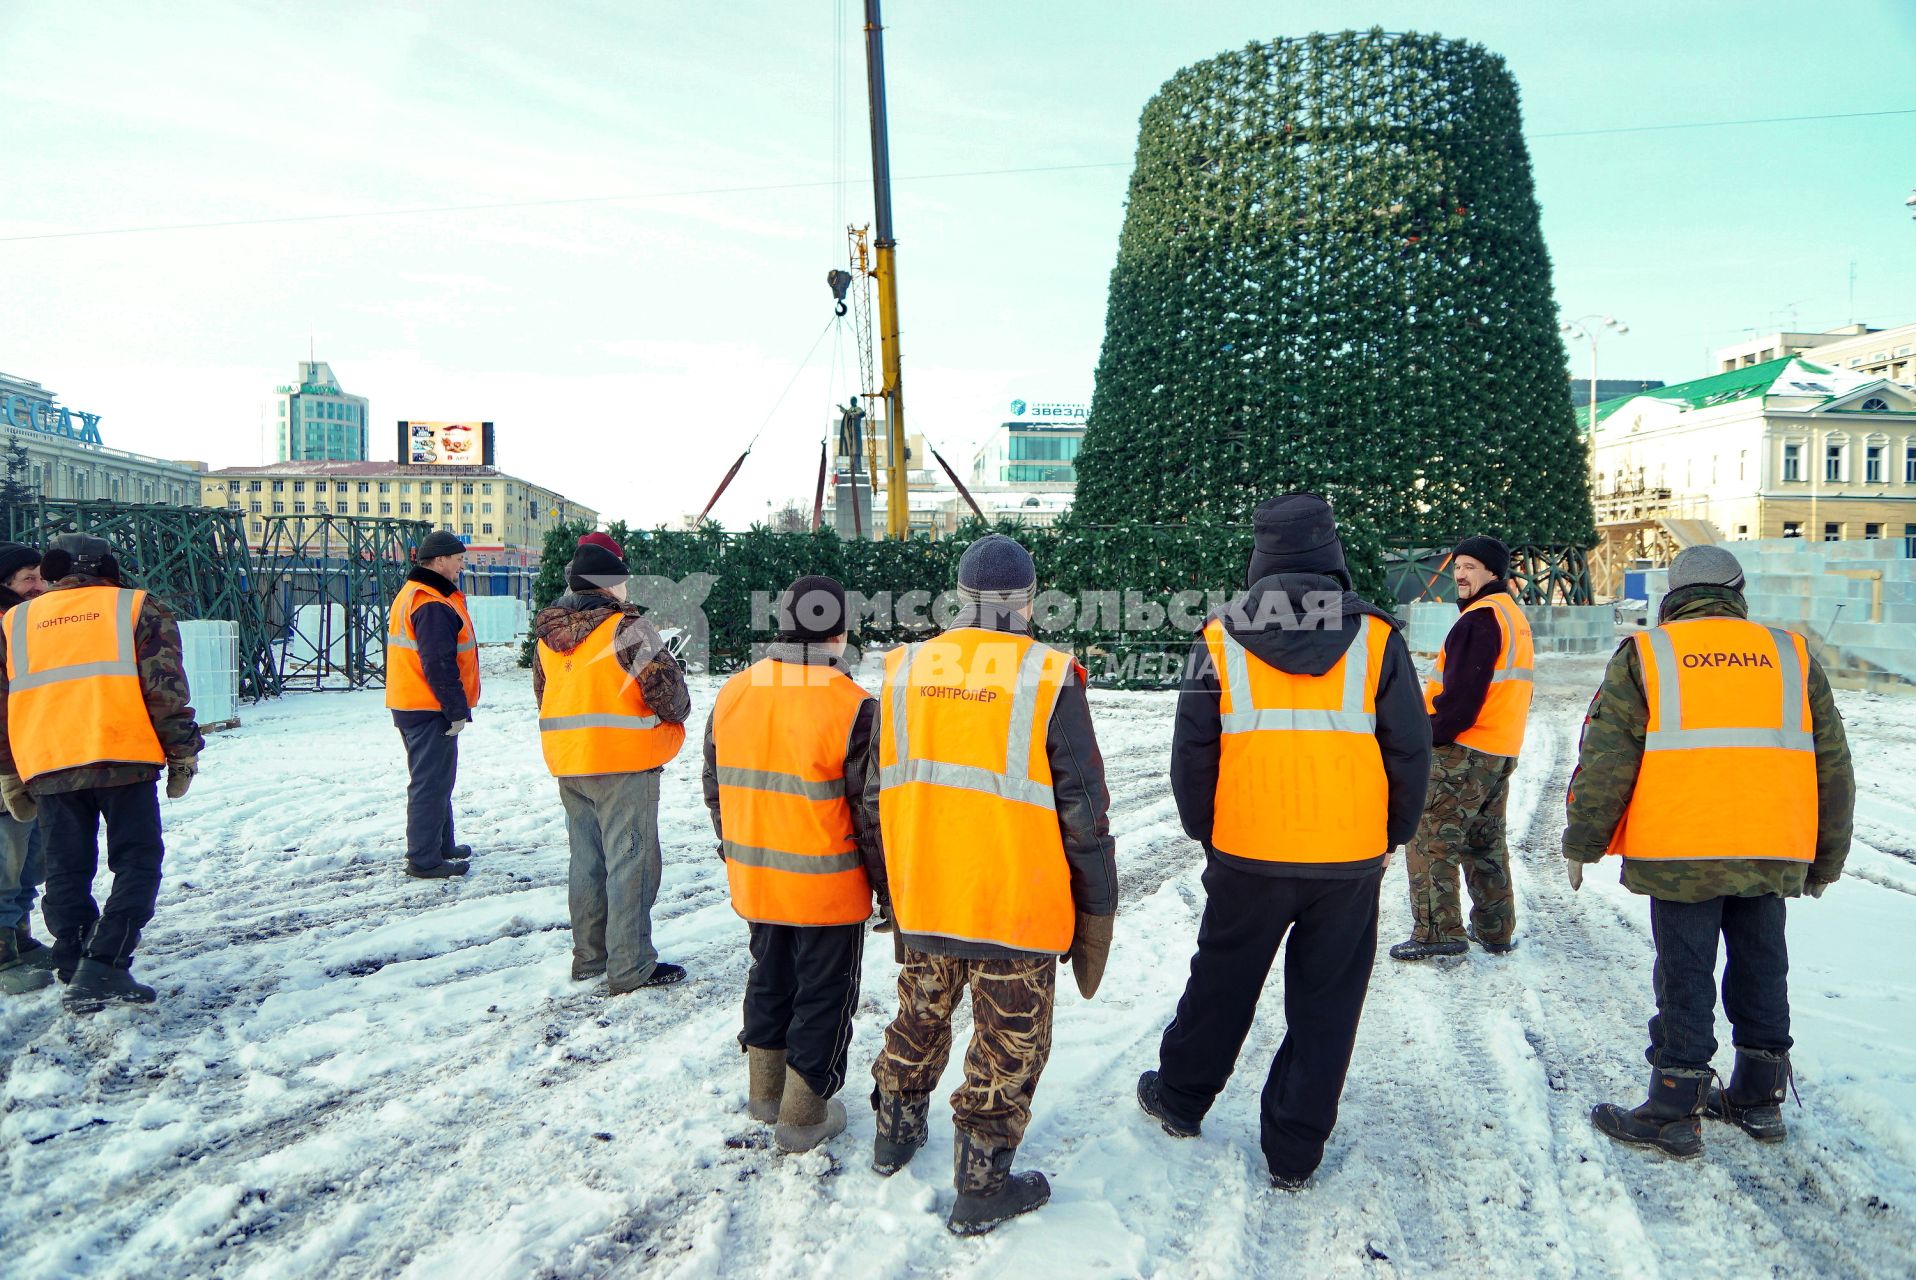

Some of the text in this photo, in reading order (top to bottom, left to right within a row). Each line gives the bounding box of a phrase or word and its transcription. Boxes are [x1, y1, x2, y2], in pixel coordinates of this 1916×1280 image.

[37, 612, 100, 630] КОНТРОЛЁР
[1683, 653, 1773, 668] ОХРАНА
[920, 686, 997, 703] КОНТРОЛЁР
